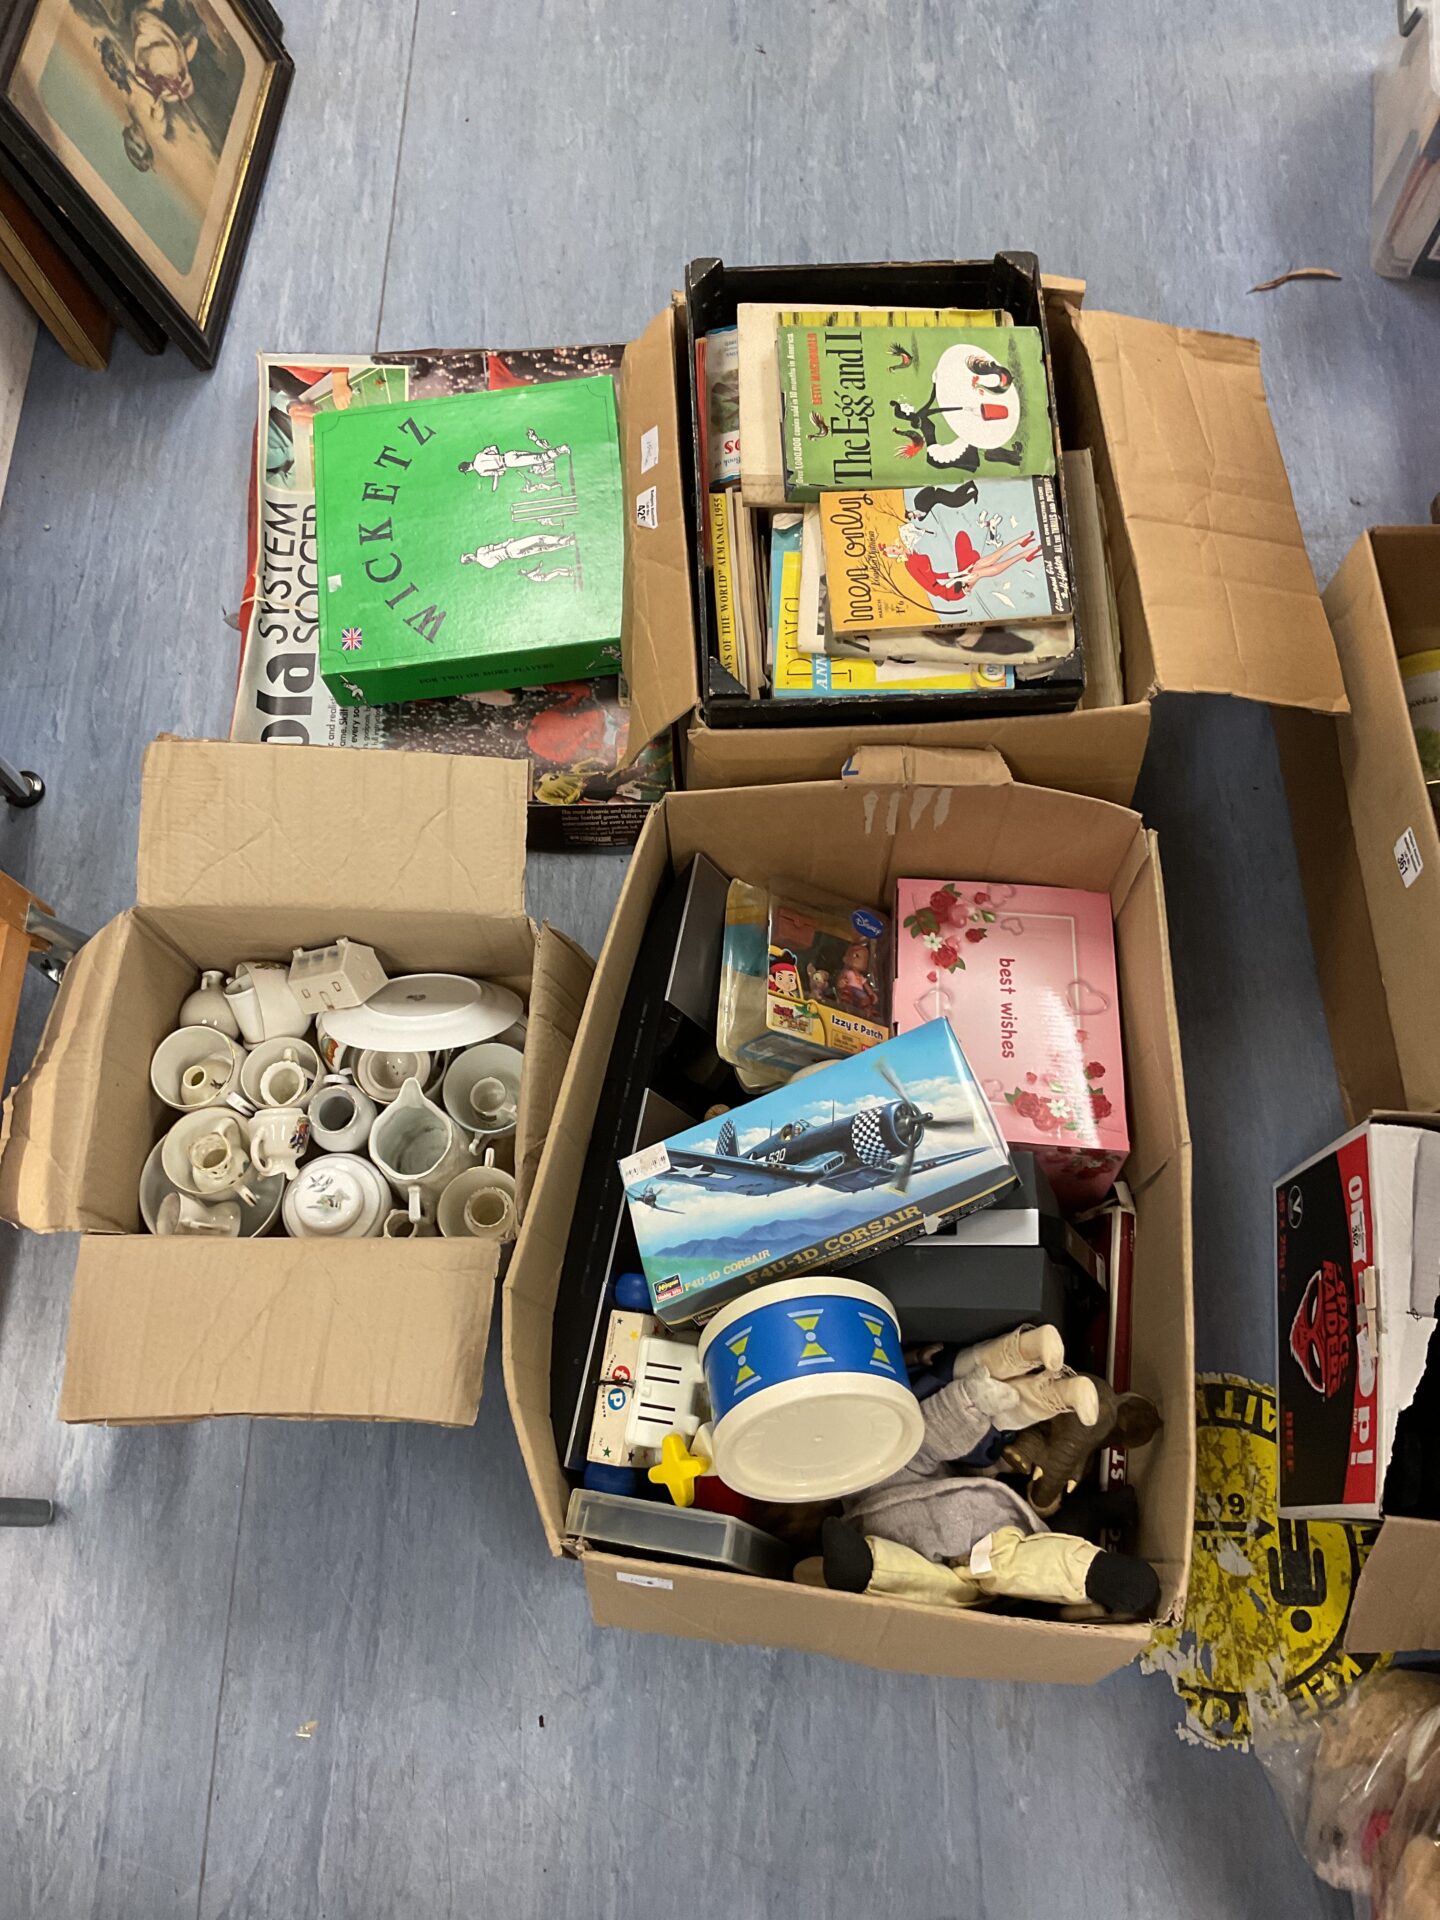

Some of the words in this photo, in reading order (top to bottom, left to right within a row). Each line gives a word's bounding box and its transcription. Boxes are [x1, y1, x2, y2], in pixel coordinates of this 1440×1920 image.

[807, 333, 820, 381] MACDONALD
[824, 331, 863, 344] I
[825, 347, 866, 390] and
[811, 384, 823, 405] BETTY
[830, 390, 875, 436] Egg
[833, 438, 873, 484] The
[358, 416, 447, 644] WICKETZ
[830, 493, 874, 558] only
[1049, 513, 1060, 534] THRILLS
[1053, 544, 1063, 553] ALL
[258, 499, 298, 645] SYSTEM
[844, 565, 874, 624] men
[721, 615, 731, 632] THE
[723, 635, 732, 651] OF
[815, 653, 828, 690] ANN
[326, 723, 335, 740] and
[340, 726, 348, 747] ame.
[351, 719, 361, 743] every
[855, 915, 882, 936] Disney
[999, 957, 1016, 995] best
[831, 1014, 852, 1032] Izzy
[860, 1024, 884, 1041] Patch
[1000, 1002, 1018, 1059] wishes
[745, 1247, 819, 1285] F4U-1D
[824, 1204, 922, 1252] CORSAIR
[683, 1270, 721, 1292] F4U-1D
[723, 1248, 771, 1276] CORSAIR
[1321, 1259, 1338, 1399] RAIDERS
[1336, 1279, 1350, 1374] SPACE
[1215, 1390, 1277, 1433] AIT
